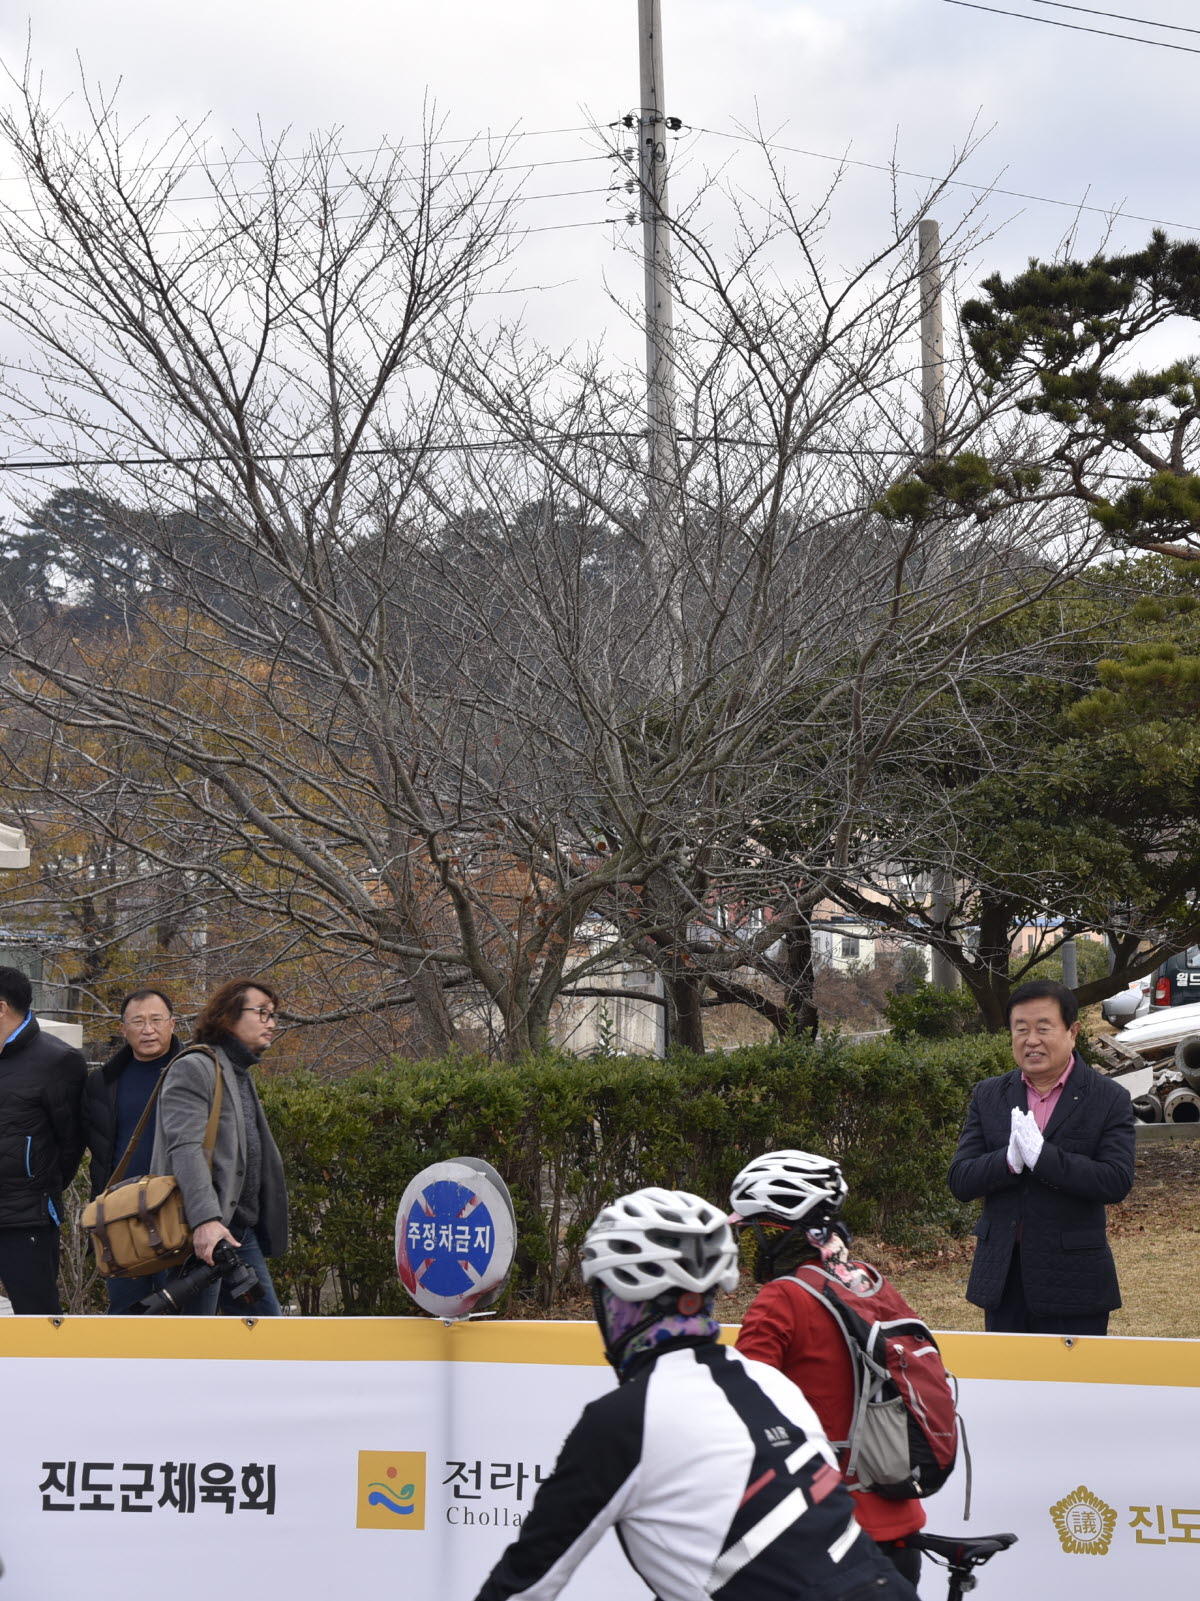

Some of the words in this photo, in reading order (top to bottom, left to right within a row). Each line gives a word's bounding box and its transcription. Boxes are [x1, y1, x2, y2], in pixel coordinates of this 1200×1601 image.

[1176, 972, 1200, 987] 월드
[408, 1222, 491, 1255] 주정차금지
[38, 1460, 277, 1516] 진도군체육회
[441, 1460, 547, 1501] 전라
